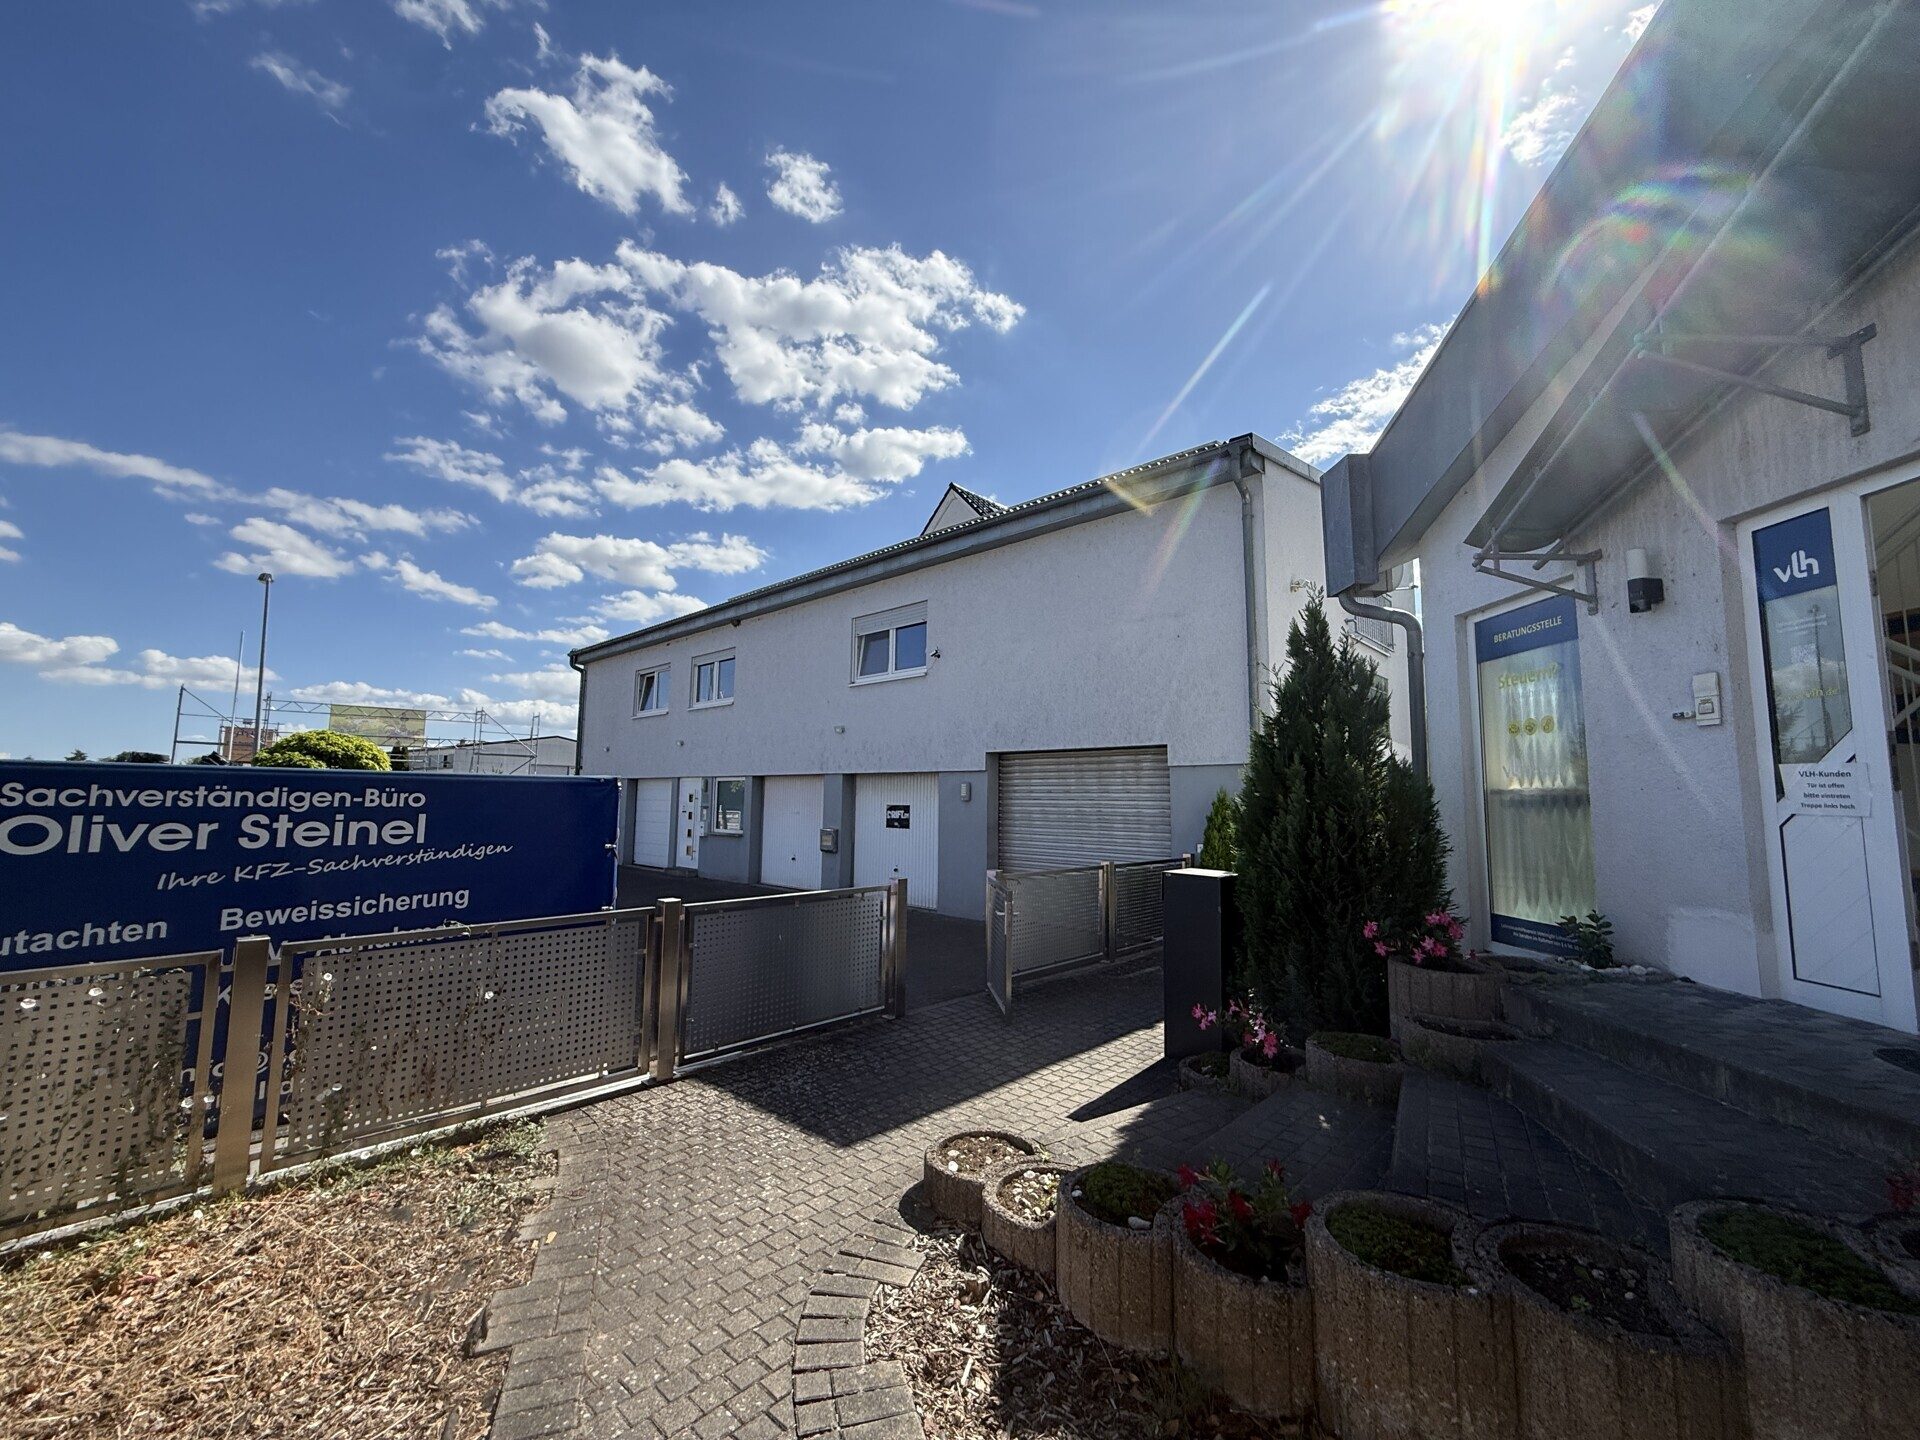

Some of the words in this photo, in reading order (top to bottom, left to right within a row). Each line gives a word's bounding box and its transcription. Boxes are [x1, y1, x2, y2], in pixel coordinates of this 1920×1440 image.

[1773, 550, 1820, 583] vlh
[1493, 616, 1562, 643] BERATUNGSSTELLE
[0, 782, 427, 812] Sachverständigen-Büro
[1800, 802, 1823, 810] Treppe
[0, 814, 220, 856] Oliver
[237, 813, 427, 850] Steinel
[156, 871, 226, 891] Ihre
[233, 843, 514, 883] KFZ-Sachverständigen
[219, 889, 470, 931] Beweissicherung
